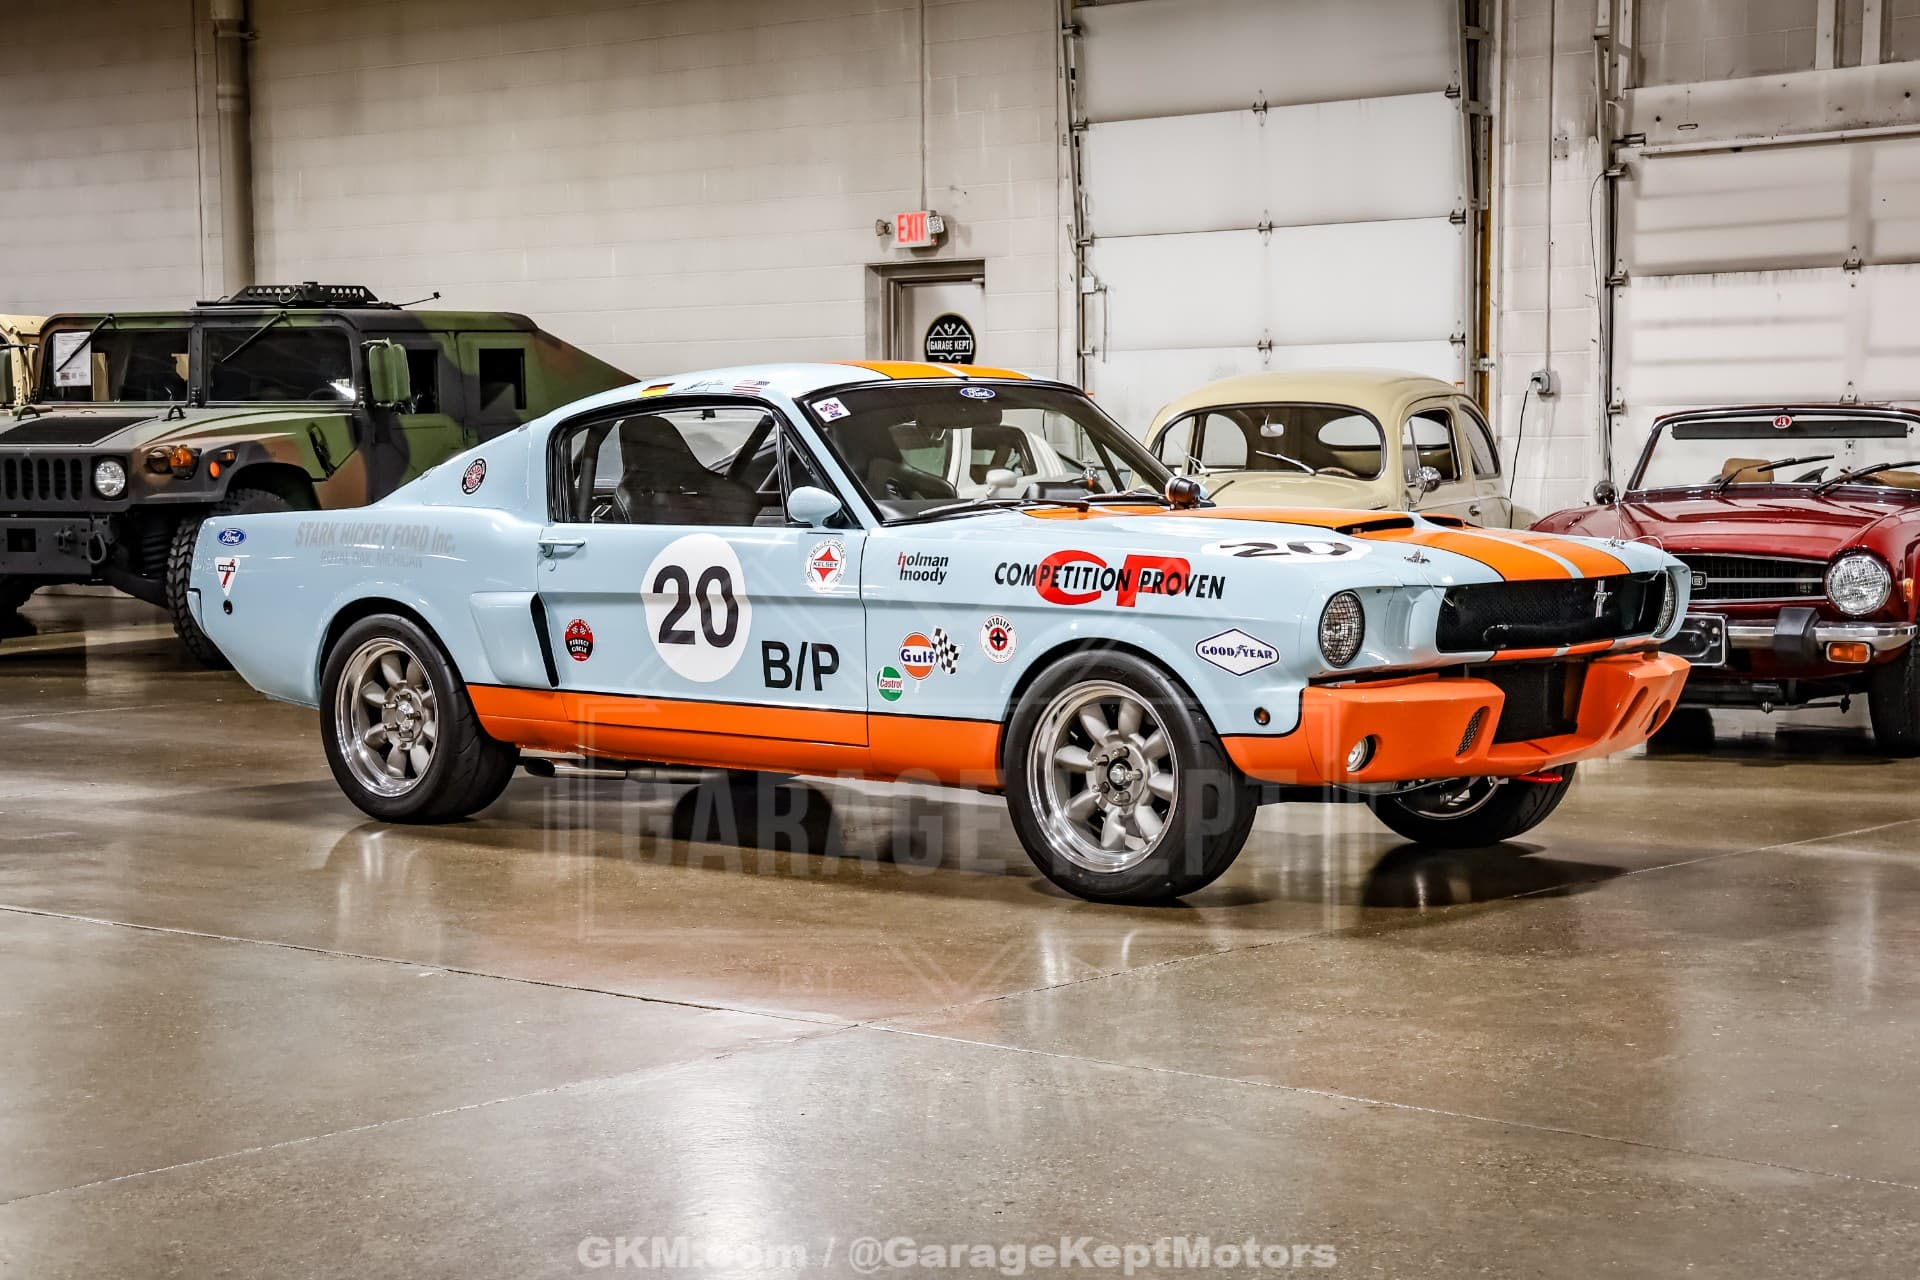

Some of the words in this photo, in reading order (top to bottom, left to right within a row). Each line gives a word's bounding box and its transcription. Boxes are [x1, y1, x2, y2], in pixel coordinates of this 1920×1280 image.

[897, 212, 926, 243] EXIT
[930, 340, 953, 351] GARAGE
[954, 340, 970, 350] KEPT
[296, 522, 337, 548] STARK
[340, 522, 392, 547] HICKEY
[392, 523, 430, 552] FORD
[1220, 541, 1353, 558] 20
[897, 551, 949, 568] holman
[899, 567, 948, 585] moody
[994, 561, 1132, 592] COMPETITION
[1138, 569, 1226, 600] PROVEN
[653, 565, 739, 648] 20
[985, 617, 1013, 633] AUTOLITE
[900, 648, 935, 663] Gulf
[761, 640, 840, 692] B/P
[880, 678, 903, 689] Castrol
